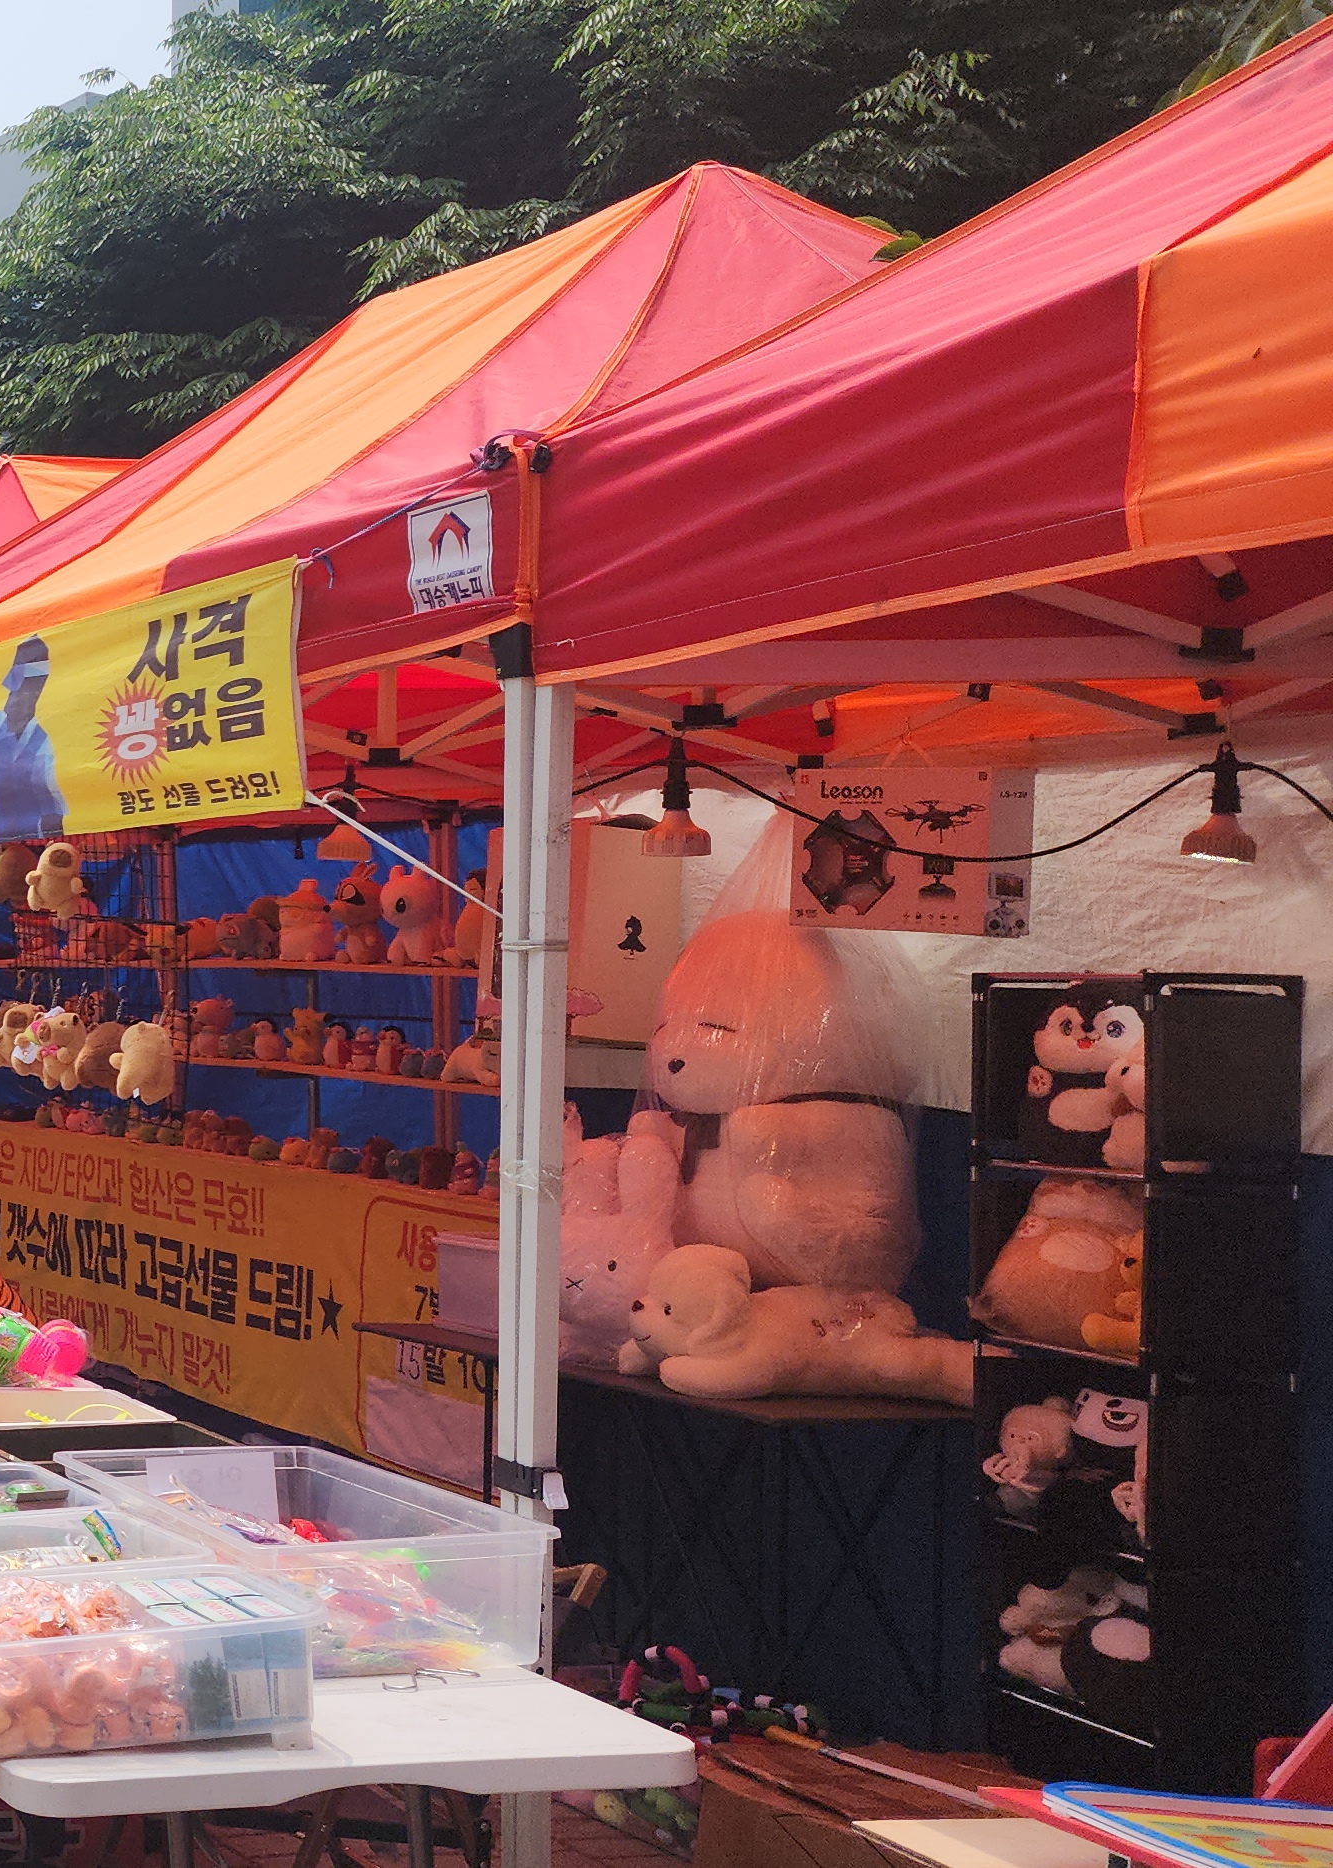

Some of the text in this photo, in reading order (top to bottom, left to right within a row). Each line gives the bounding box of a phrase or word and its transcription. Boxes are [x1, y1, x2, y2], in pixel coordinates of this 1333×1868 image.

[126, 594, 253, 685] 사격
[113, 677, 265, 760] 꽝없음
[162, 782, 201, 810] 선물
[205, 770, 281, 804] 드려요!
[820, 780, 884, 799] Leason
[19, 1144, 123, 1207] 지인/타인과
[129, 1160, 196, 1226] 합산은
[203, 1179, 265, 1238] 무효!!
[6, 1201, 72, 1278] 갯수에
[75, 1217, 127, 1290] 따라
[133, 1229, 238, 1325] 고급선물
[115, 1307, 174, 1376] 겨누지
[182, 1330, 231, 1396] 말것!
